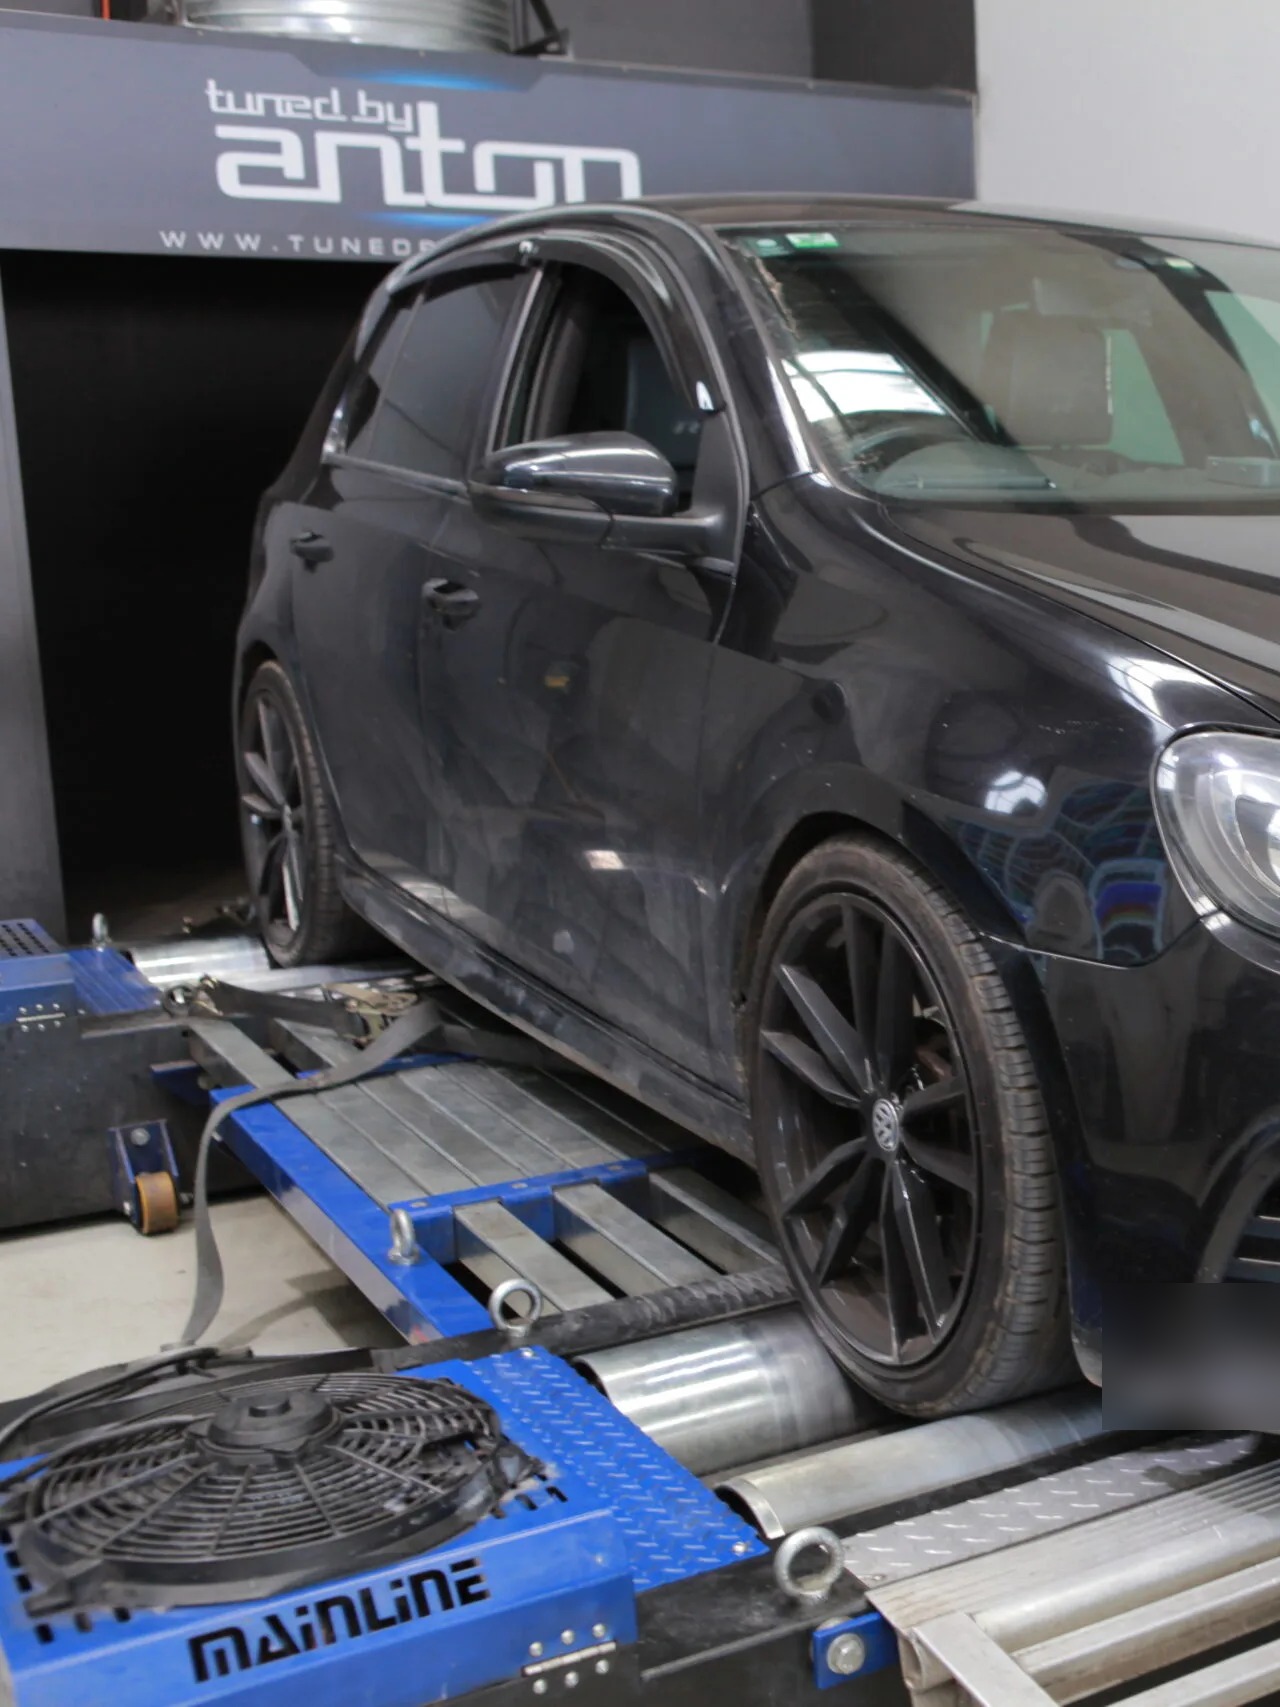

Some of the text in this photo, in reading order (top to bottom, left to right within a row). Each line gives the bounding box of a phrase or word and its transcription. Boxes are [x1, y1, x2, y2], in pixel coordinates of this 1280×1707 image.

[205, 78, 414, 132] tuned by
[214, 100, 643, 212] anton
